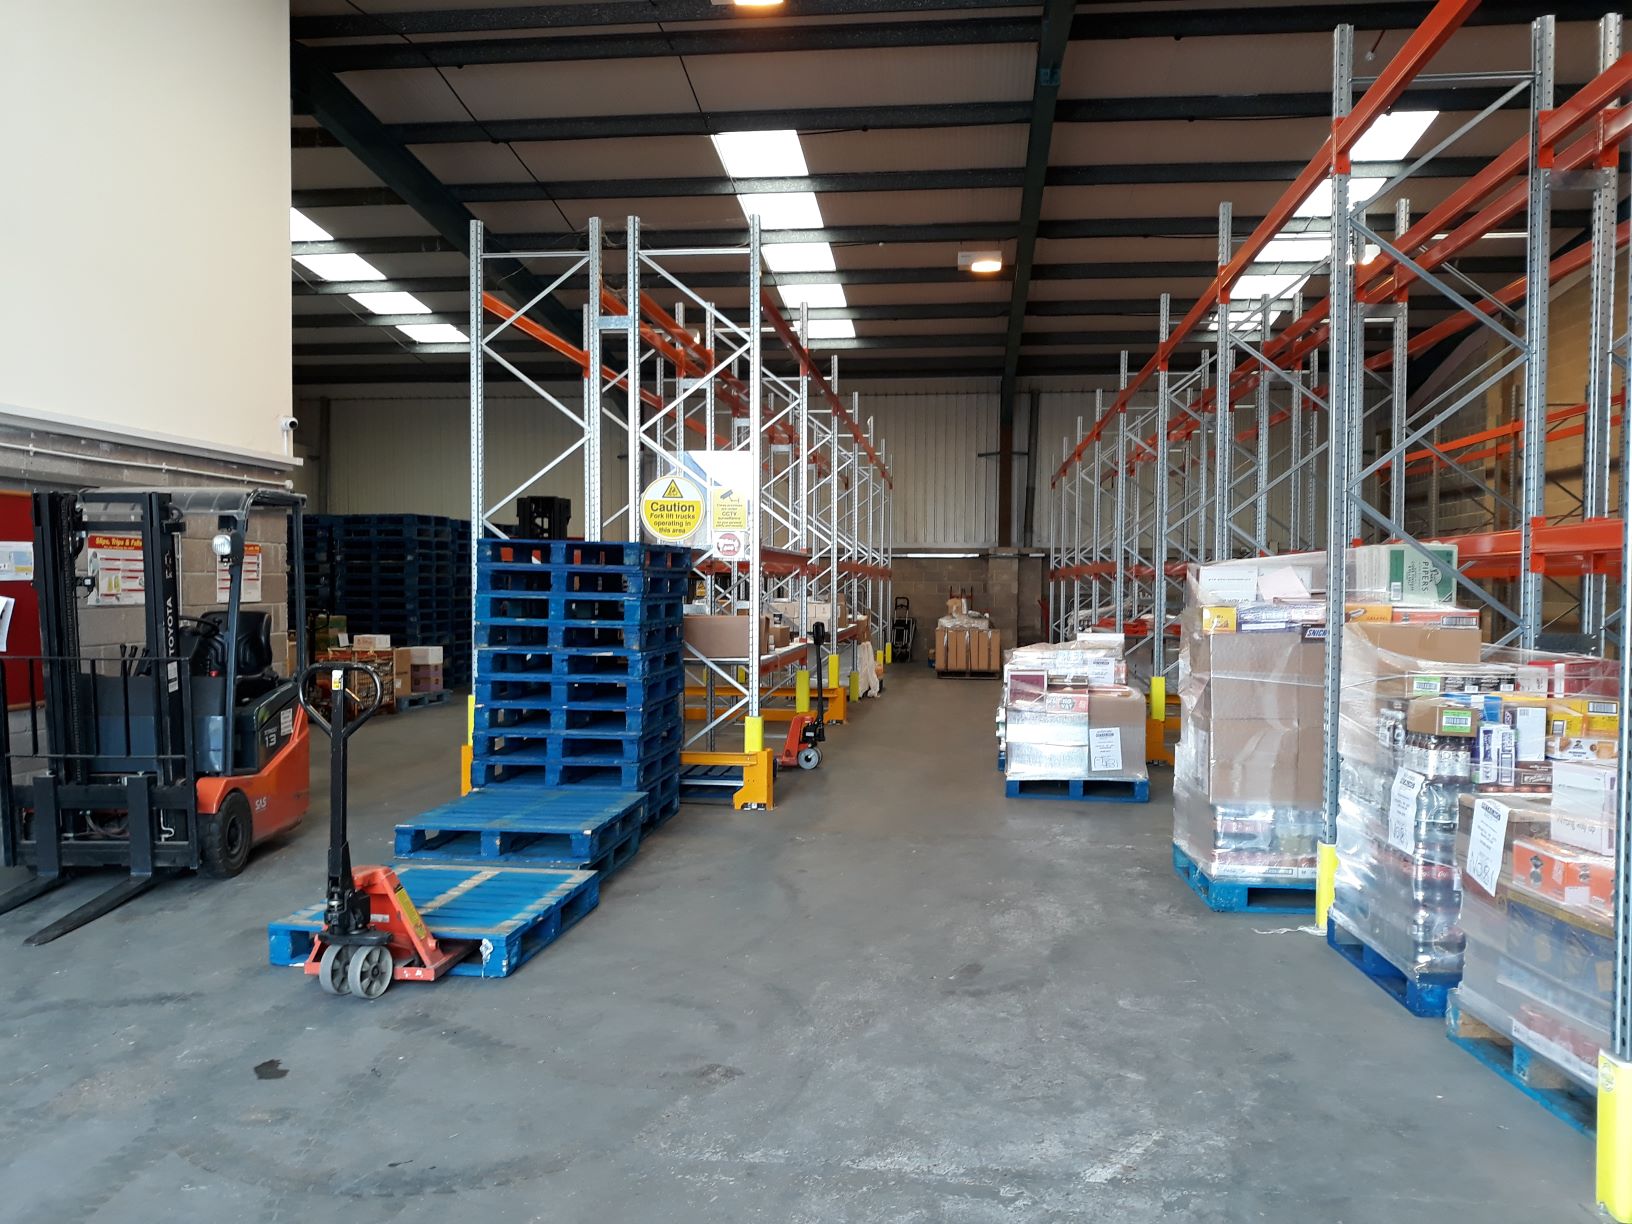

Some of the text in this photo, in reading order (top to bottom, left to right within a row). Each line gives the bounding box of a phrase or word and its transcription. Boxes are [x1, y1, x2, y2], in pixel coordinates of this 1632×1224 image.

[650, 501, 695, 512] Caution
[1421, 561, 1429, 592] PIPERS
[166, 596, 175, 657] TOYOTA
[1307, 629, 1327, 637] SNICK
[265, 733, 277, 748] 13
